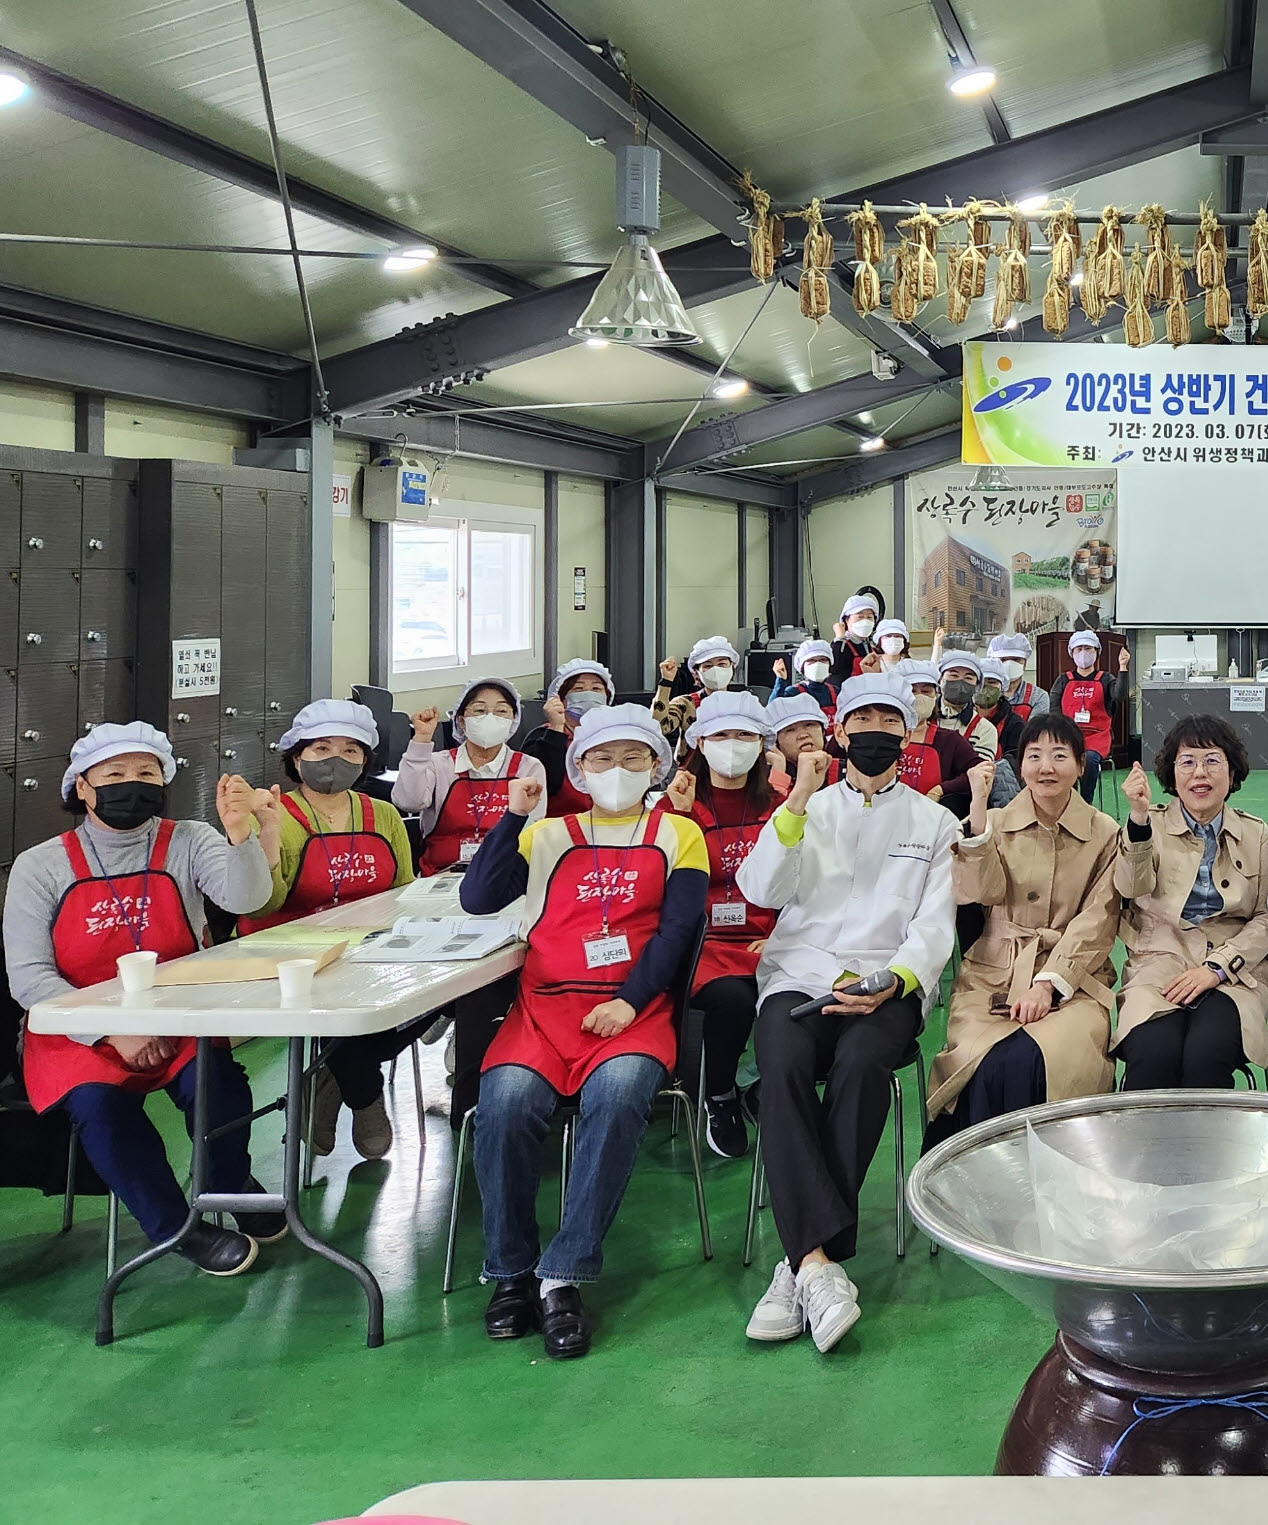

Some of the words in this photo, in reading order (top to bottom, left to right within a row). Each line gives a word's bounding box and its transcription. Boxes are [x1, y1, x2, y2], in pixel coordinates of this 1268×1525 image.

[1065, 372, 1152, 415] 2023년
[1160, 373, 1236, 416] 상반기
[1108, 422, 1147, 439] 기간:
[1152, 423, 1199, 439] 2023.
[1204, 423, 1230, 439] 03.
[1066, 445, 1102, 462] 주최:
[1141, 446, 1188, 463] 안산시
[917, 492, 979, 524] 상록수
[983, 494, 1065, 528] 된장마을
